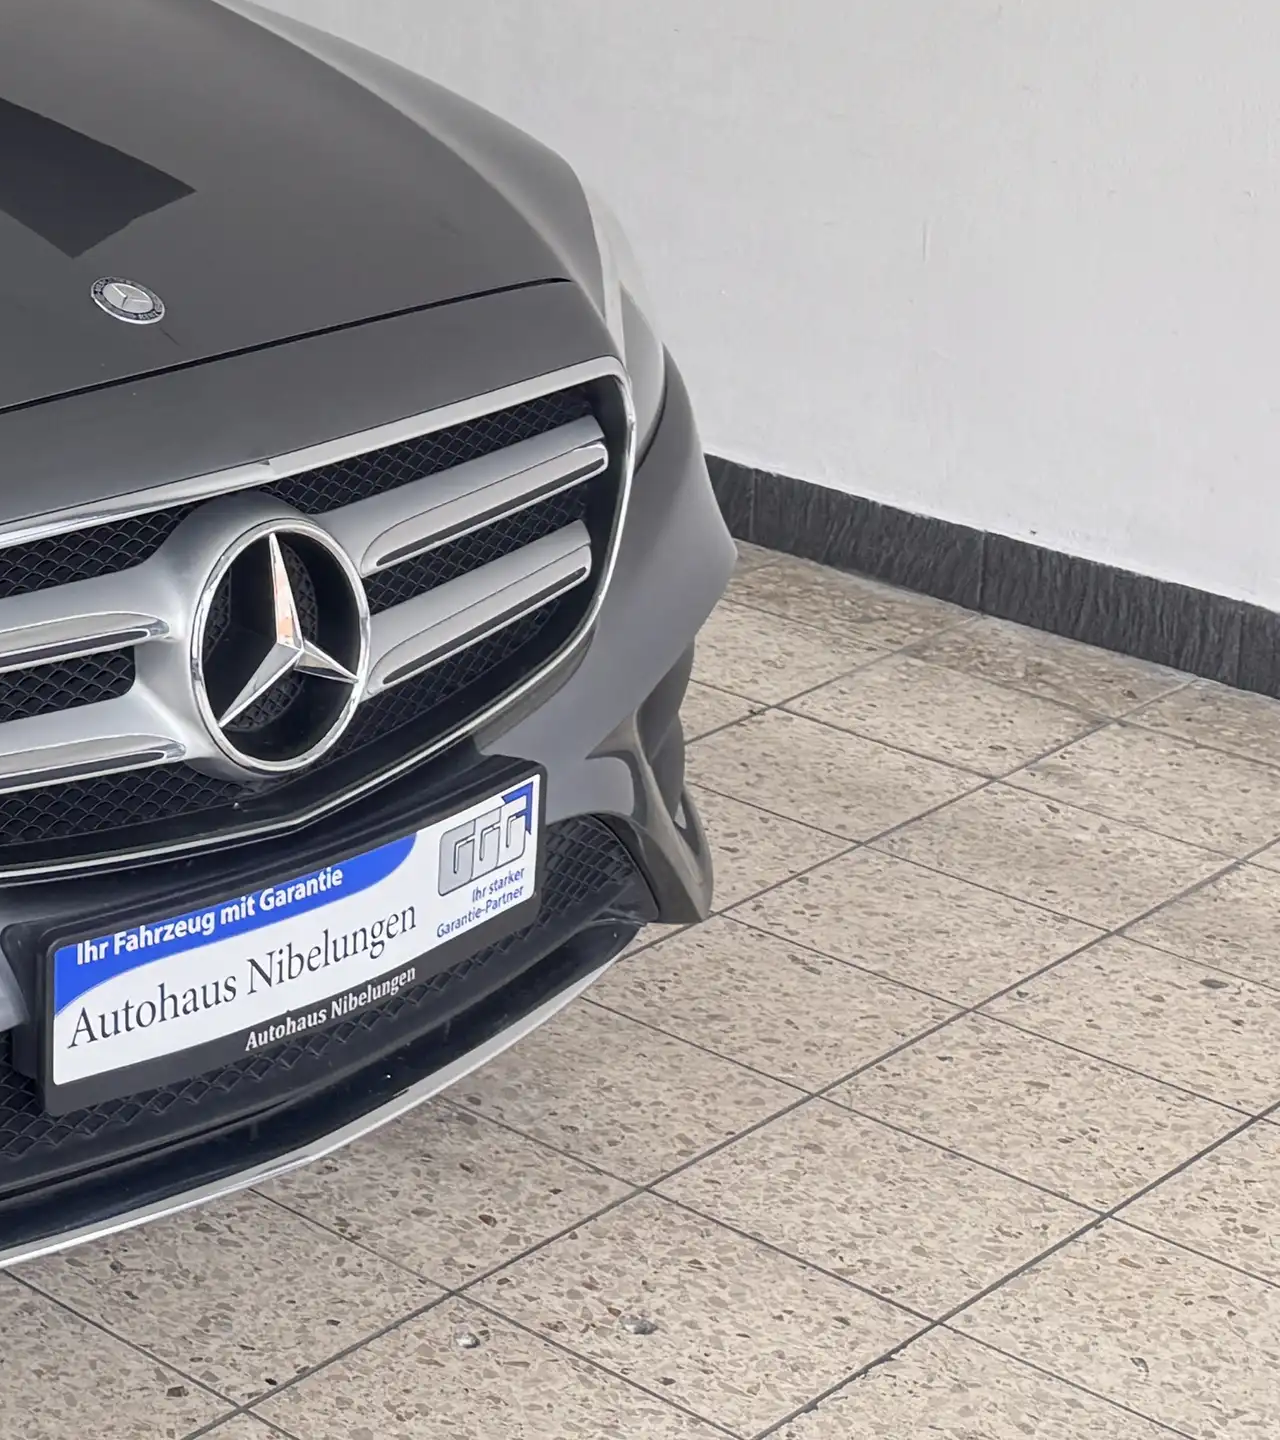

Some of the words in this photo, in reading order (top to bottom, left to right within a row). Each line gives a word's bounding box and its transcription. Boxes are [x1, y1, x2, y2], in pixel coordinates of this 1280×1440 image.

[76, 940, 110, 965] Ihr
[113, 911, 216, 955] Fahrzeug
[220, 895, 257, 925] mit
[259, 866, 344, 912] Garantie
[436, 885, 525, 938] Garantie-Partner
[472, 886, 488, 903] Ihr
[489, 868, 526, 895] starker
[67, 975, 238, 1050] Autohaus
[246, 905, 417, 996] Nibelungen
[245, 1008, 328, 1052] Autohaus
[330, 966, 417, 1020] Nibelungen
